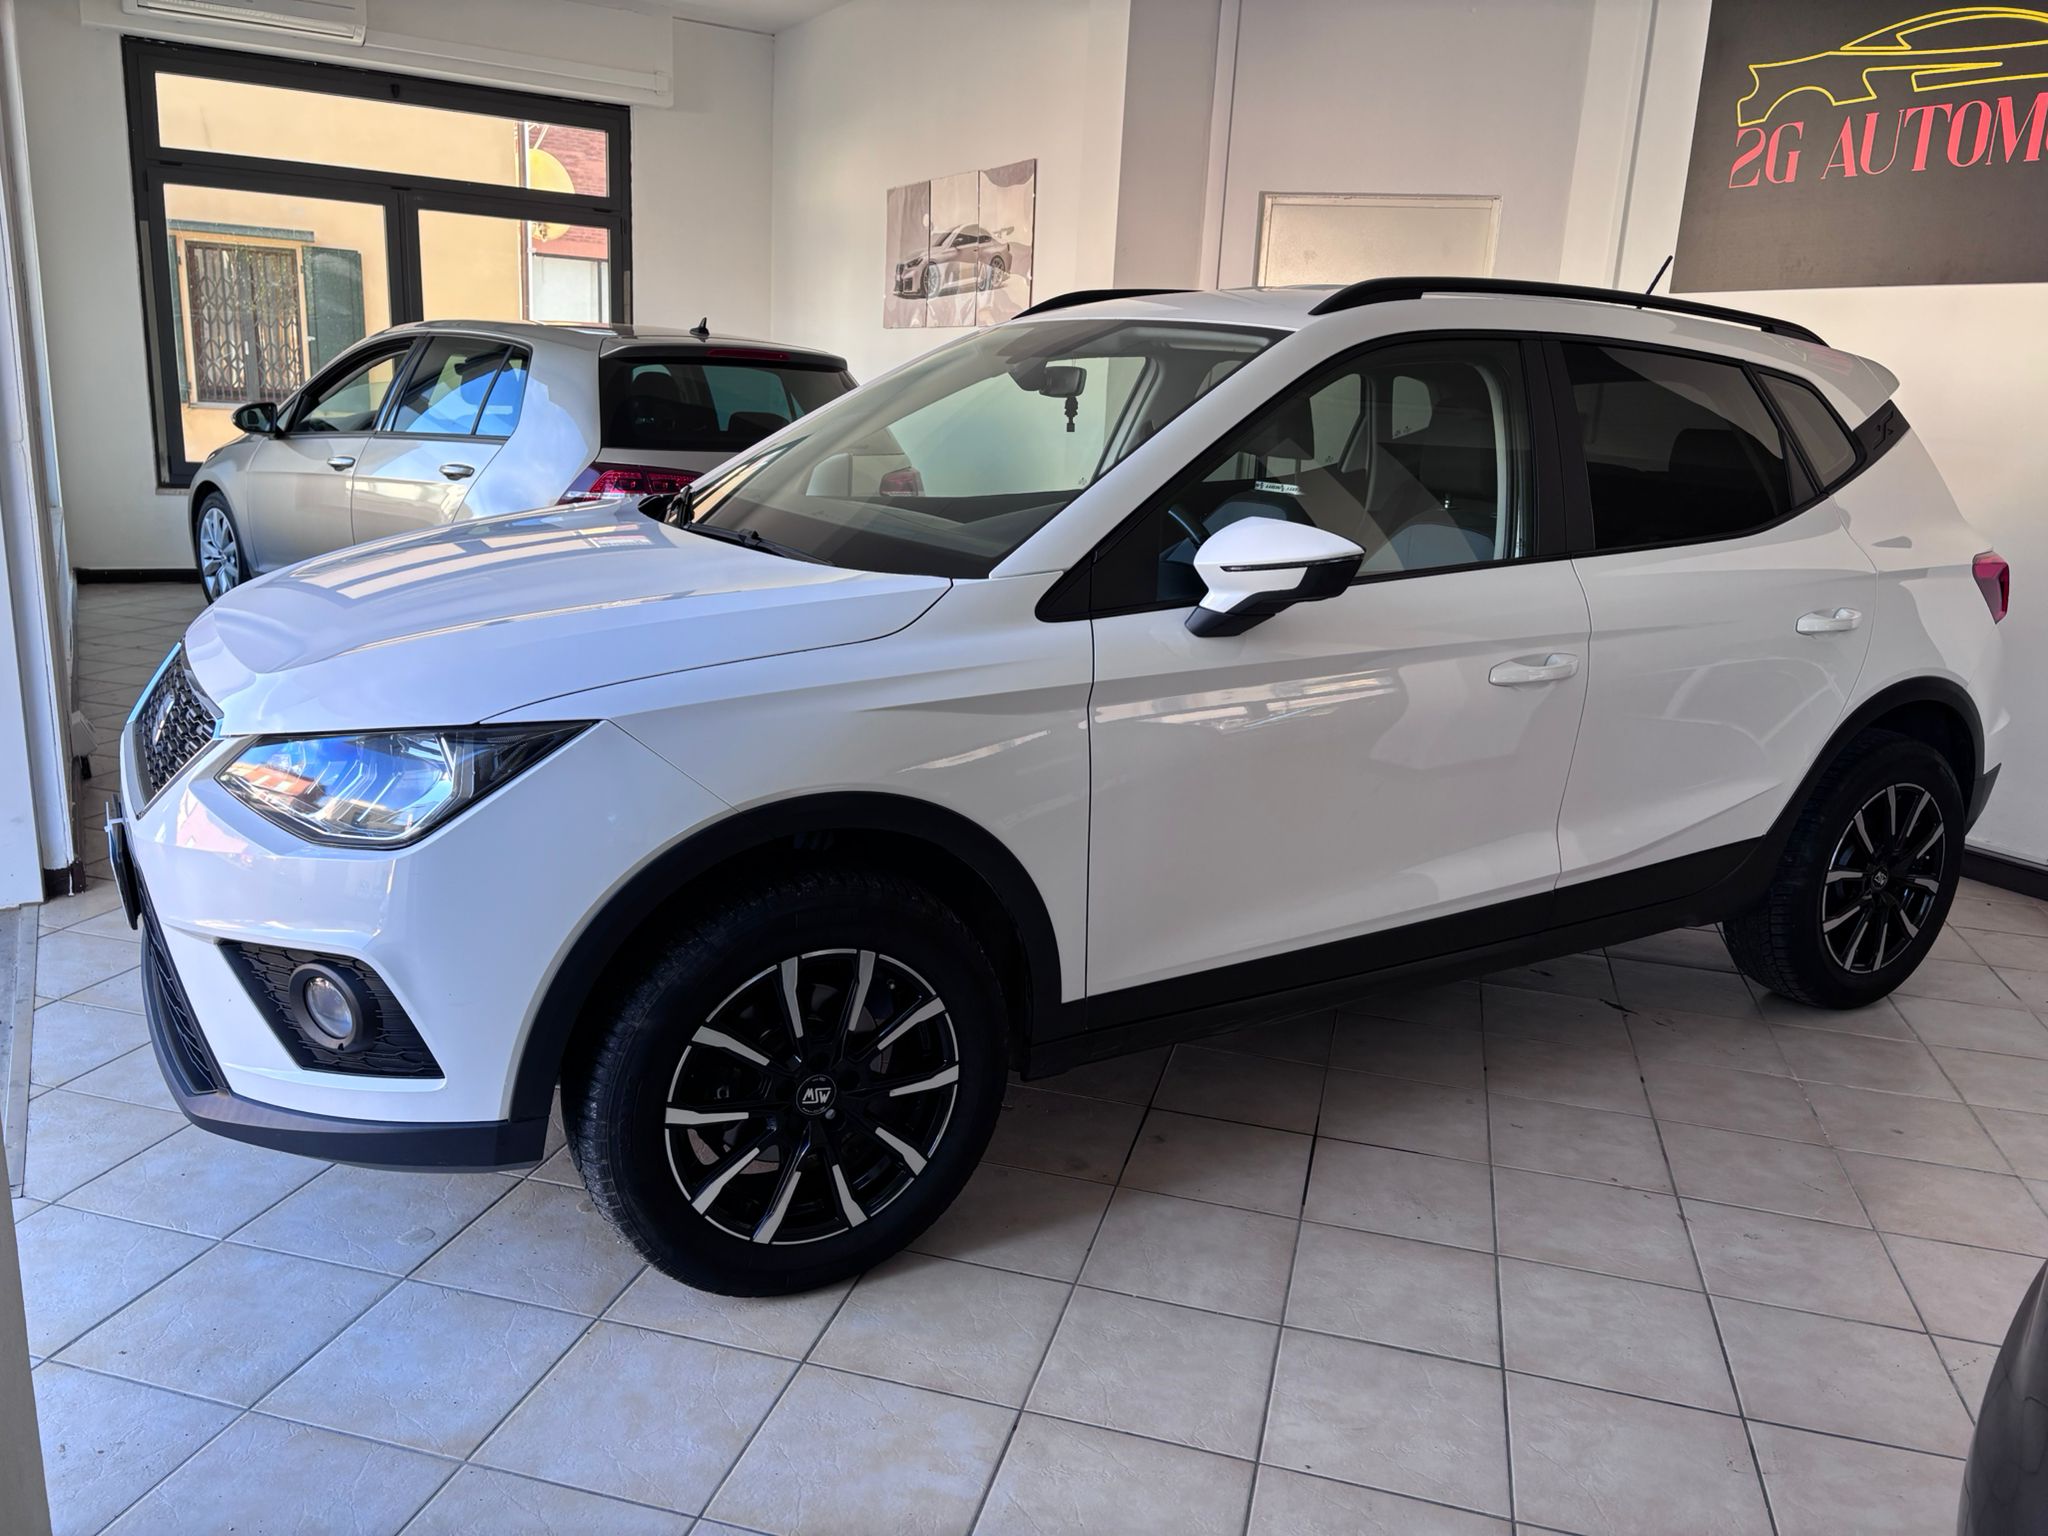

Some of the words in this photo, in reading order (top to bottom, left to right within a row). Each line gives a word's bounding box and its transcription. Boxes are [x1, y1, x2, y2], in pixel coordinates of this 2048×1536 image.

[1728, 121, 1804, 189] 2G
[1820, 91, 2048, 180] AUTOM
[801, 1087, 832, 1104] MSW
